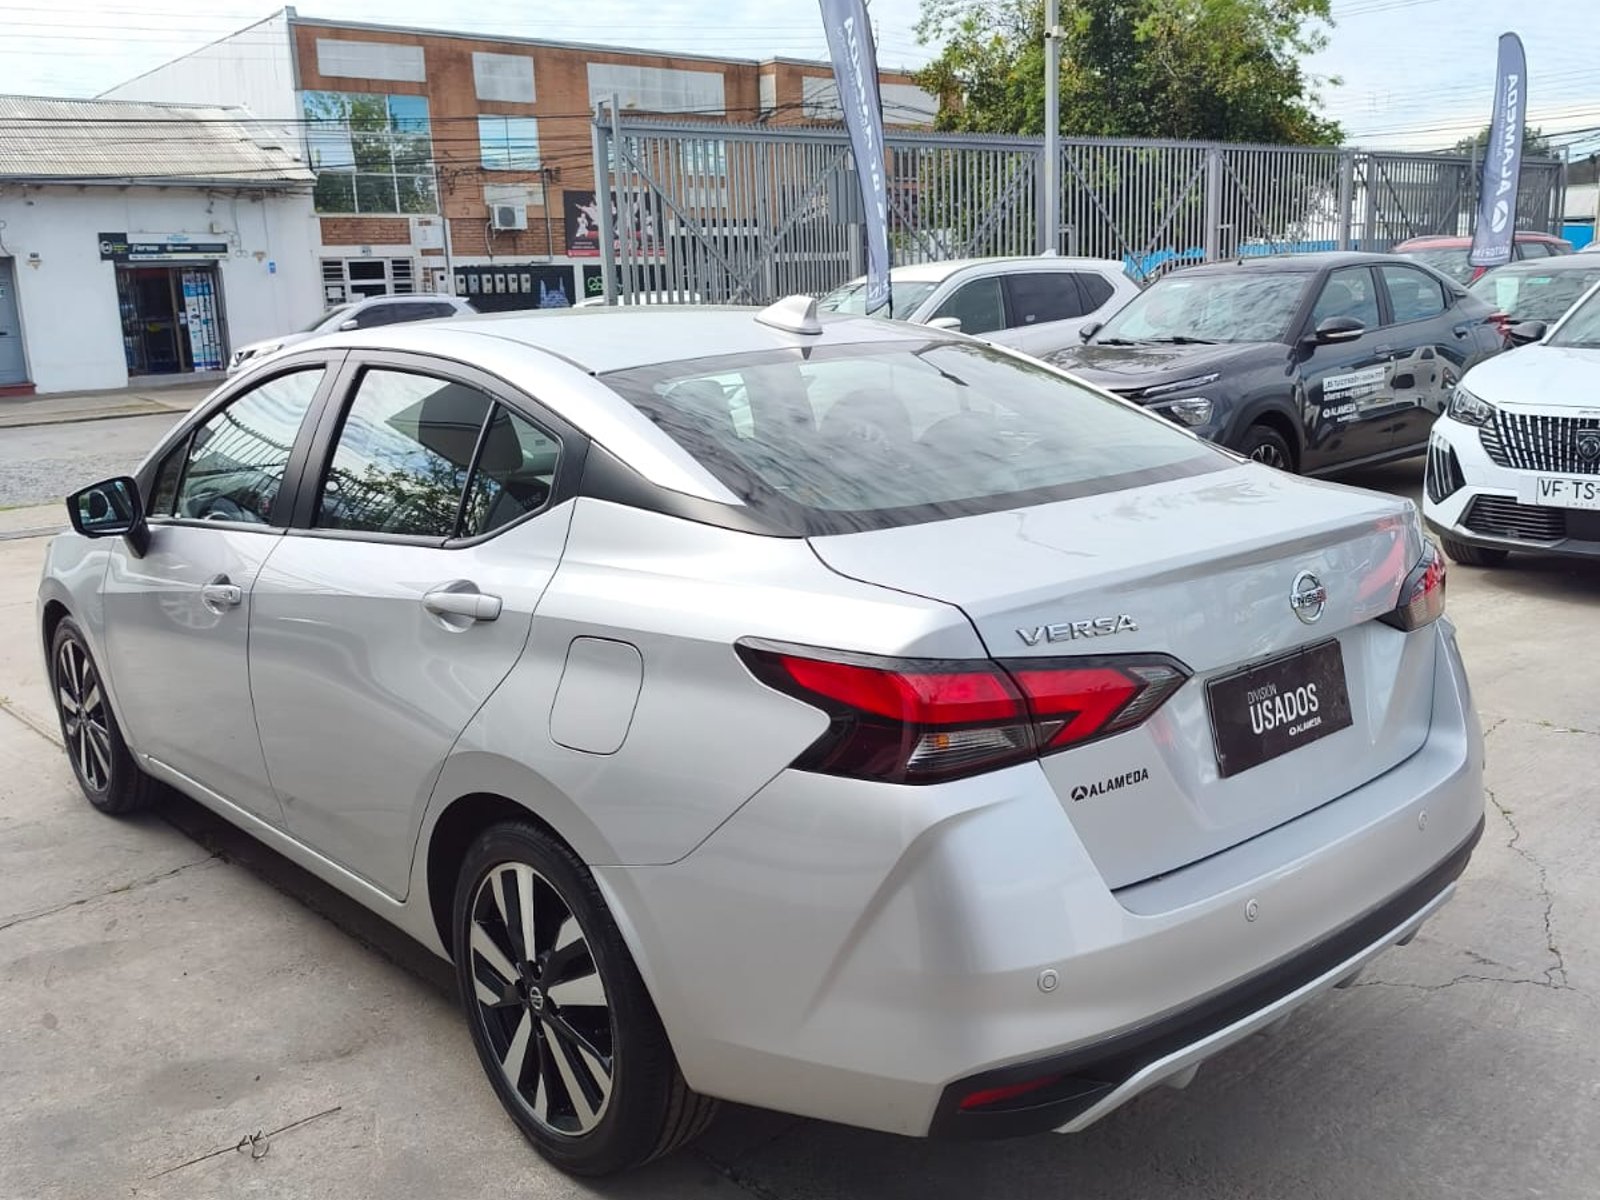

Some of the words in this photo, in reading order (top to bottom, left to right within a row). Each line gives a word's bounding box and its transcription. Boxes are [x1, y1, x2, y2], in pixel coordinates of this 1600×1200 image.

[1015, 614, 1139, 646] VERSA
[1250, 683, 1319, 735] USADOS
[1090, 768, 1149, 798] ALAMEDA
